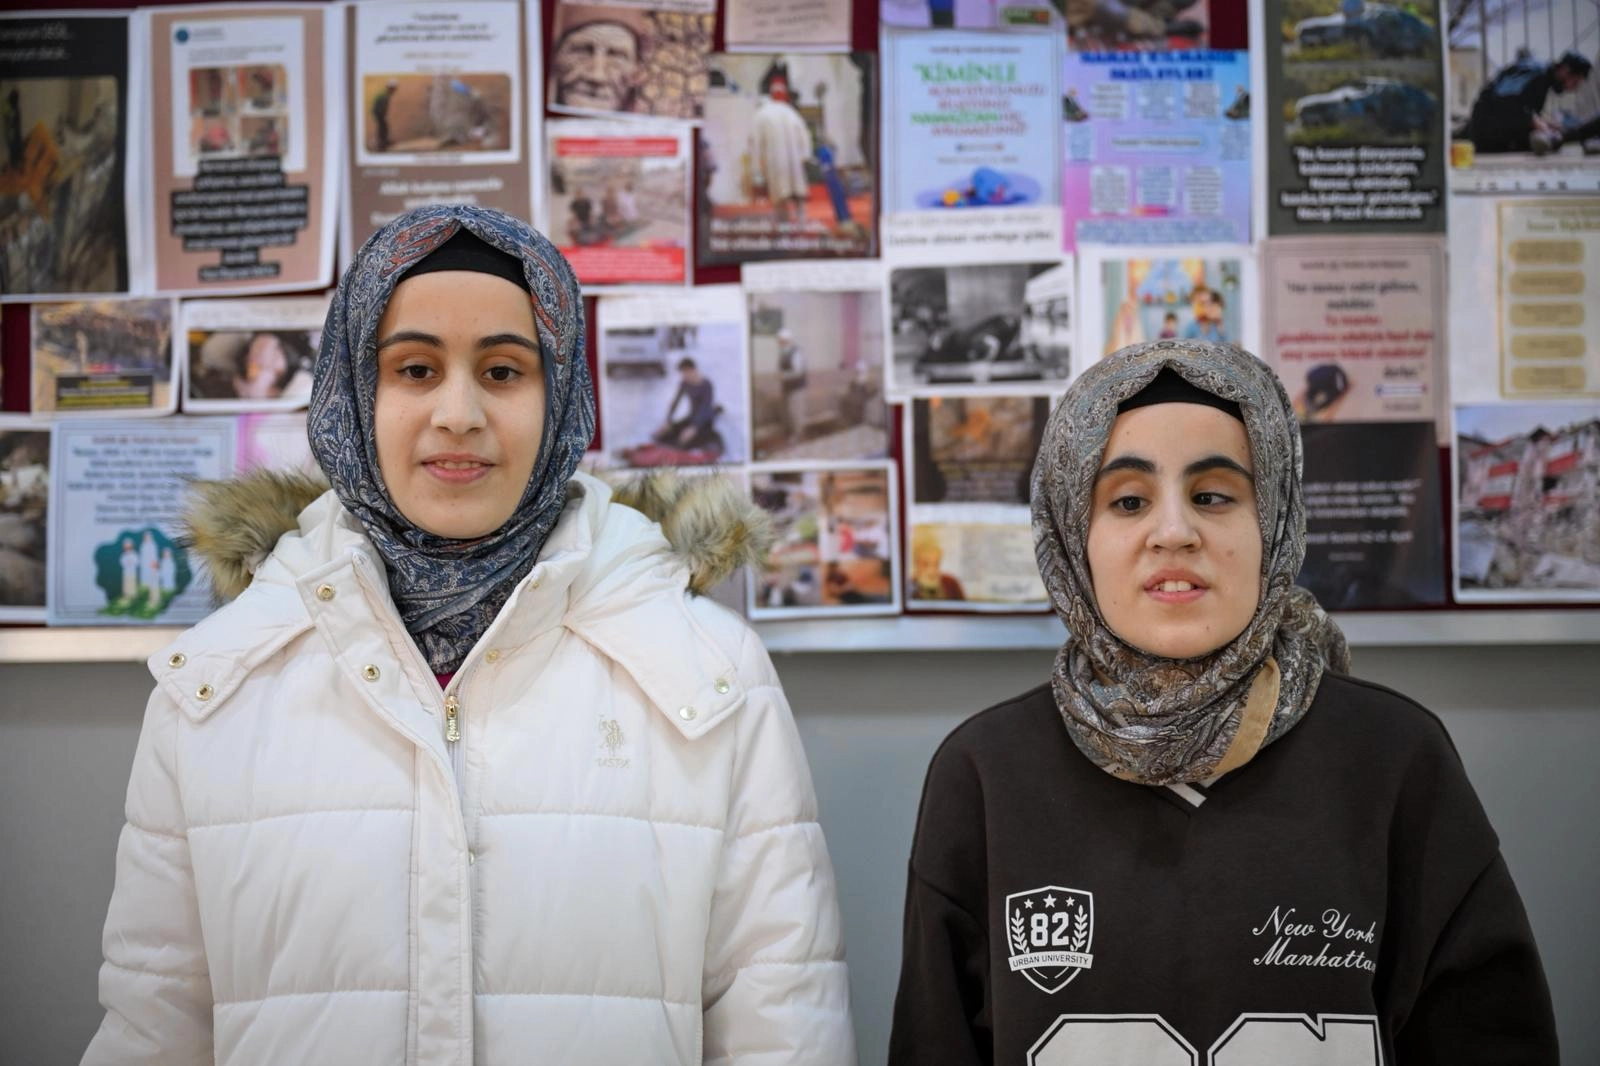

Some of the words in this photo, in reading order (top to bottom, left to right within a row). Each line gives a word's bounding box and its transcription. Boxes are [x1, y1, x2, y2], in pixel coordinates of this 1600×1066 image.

[1030, 911, 1070, 947] 82
[1252, 905, 1316, 936] New
[1321, 908, 1377, 944] York
[1012, 955, 1040, 968] URBAN
[1041, 954, 1089, 966] UNIVERSITY
